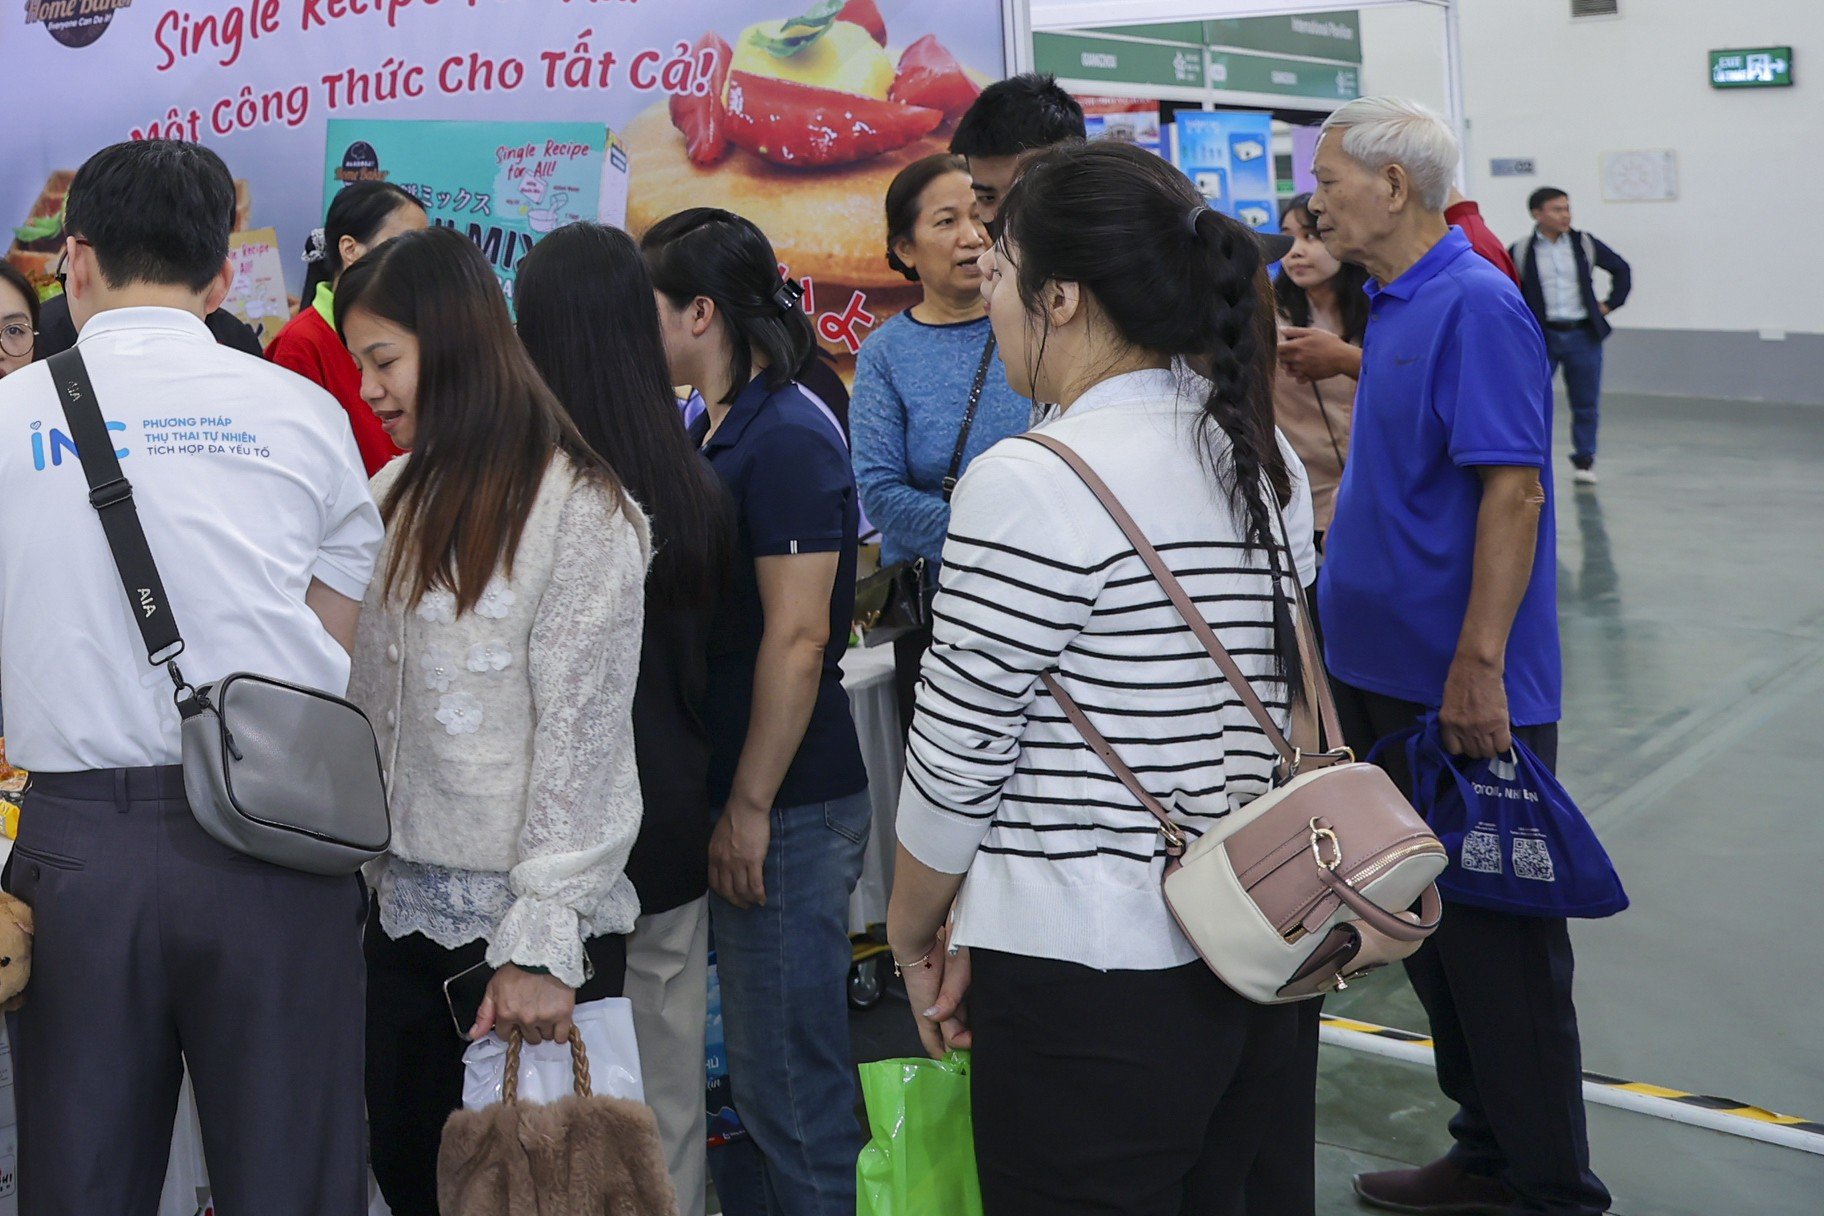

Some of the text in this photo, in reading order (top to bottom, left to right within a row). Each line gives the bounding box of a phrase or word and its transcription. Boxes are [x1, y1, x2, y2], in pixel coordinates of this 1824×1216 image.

[210, 85, 310, 128] Công
[321, 57, 425, 112] Thức
[438, 50, 524, 95] Cho
[541, 28, 617, 92] Tất
[629, 36, 716, 97] Cả!
[495, 139, 591, 165] Single Recipe
[507, 160, 557, 180] for All!
[142, 414, 232, 430] PHƯƠNG PHÁP
[144, 429, 257, 446] THỤ THAI TỰ NHIÊN
[147, 441, 271, 459] TÍCH HỢP ĐA YẾU TỐ
[137, 587, 157, 619] AIA
